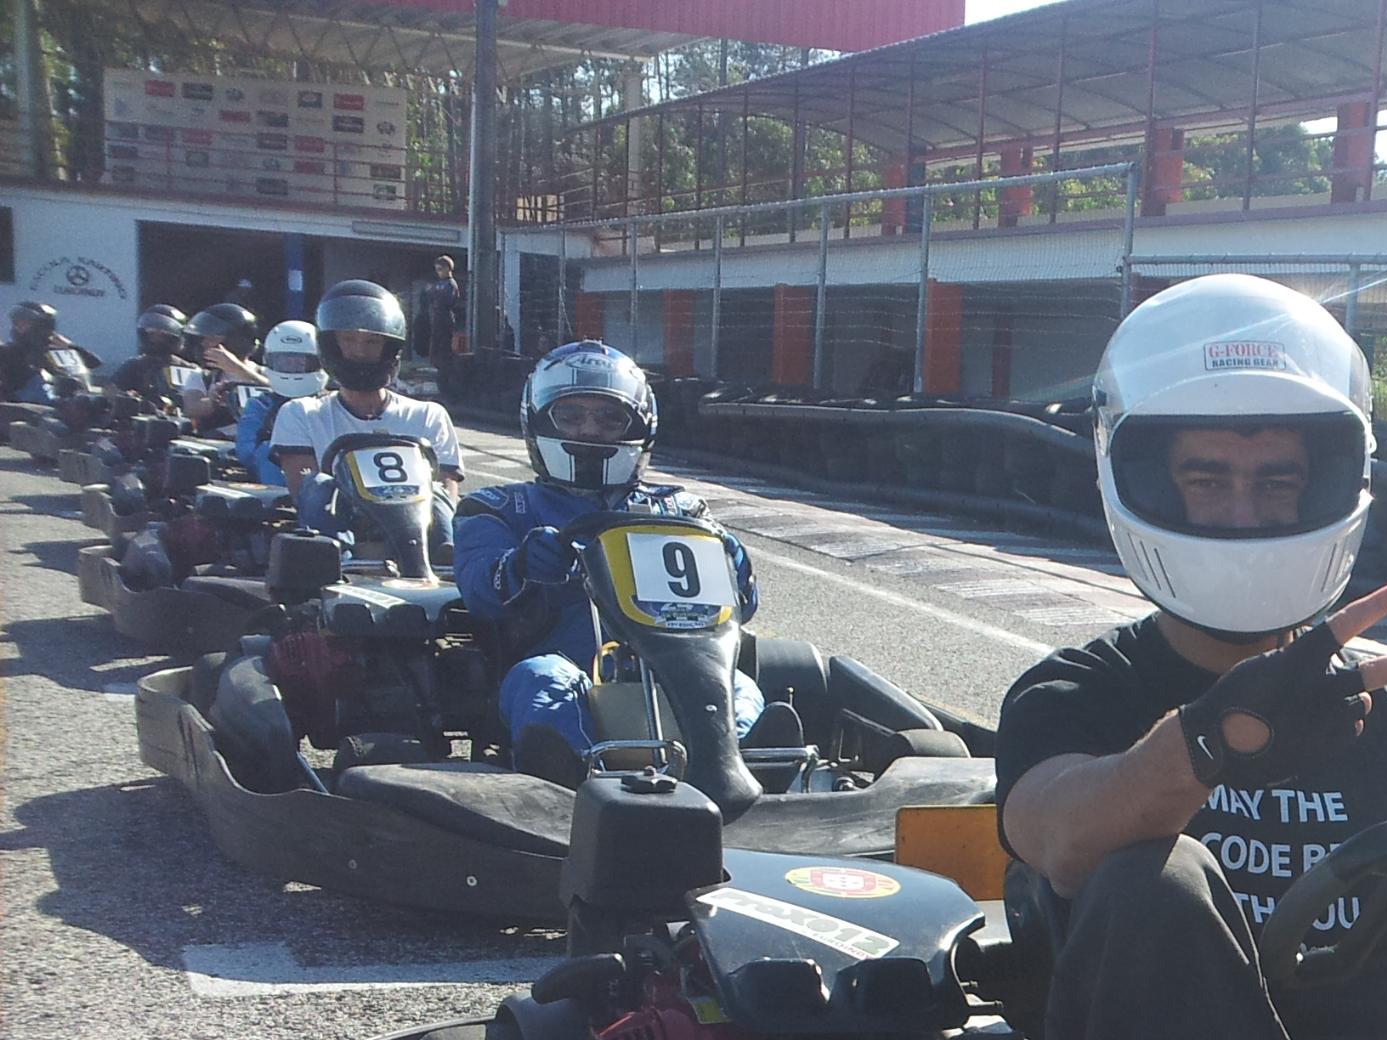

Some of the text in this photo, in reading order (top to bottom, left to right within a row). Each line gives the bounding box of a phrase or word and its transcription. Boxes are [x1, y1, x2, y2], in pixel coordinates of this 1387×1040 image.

[1208, 343, 1279, 358] G-FORCE
[1212, 358, 1279, 368] RACING GEAR
[373, 452, 408, 483] 8
[662, 541, 701, 598] 9
[1202, 784, 1348, 823] MAY THE
[1201, 832, 1292, 877] CODE
